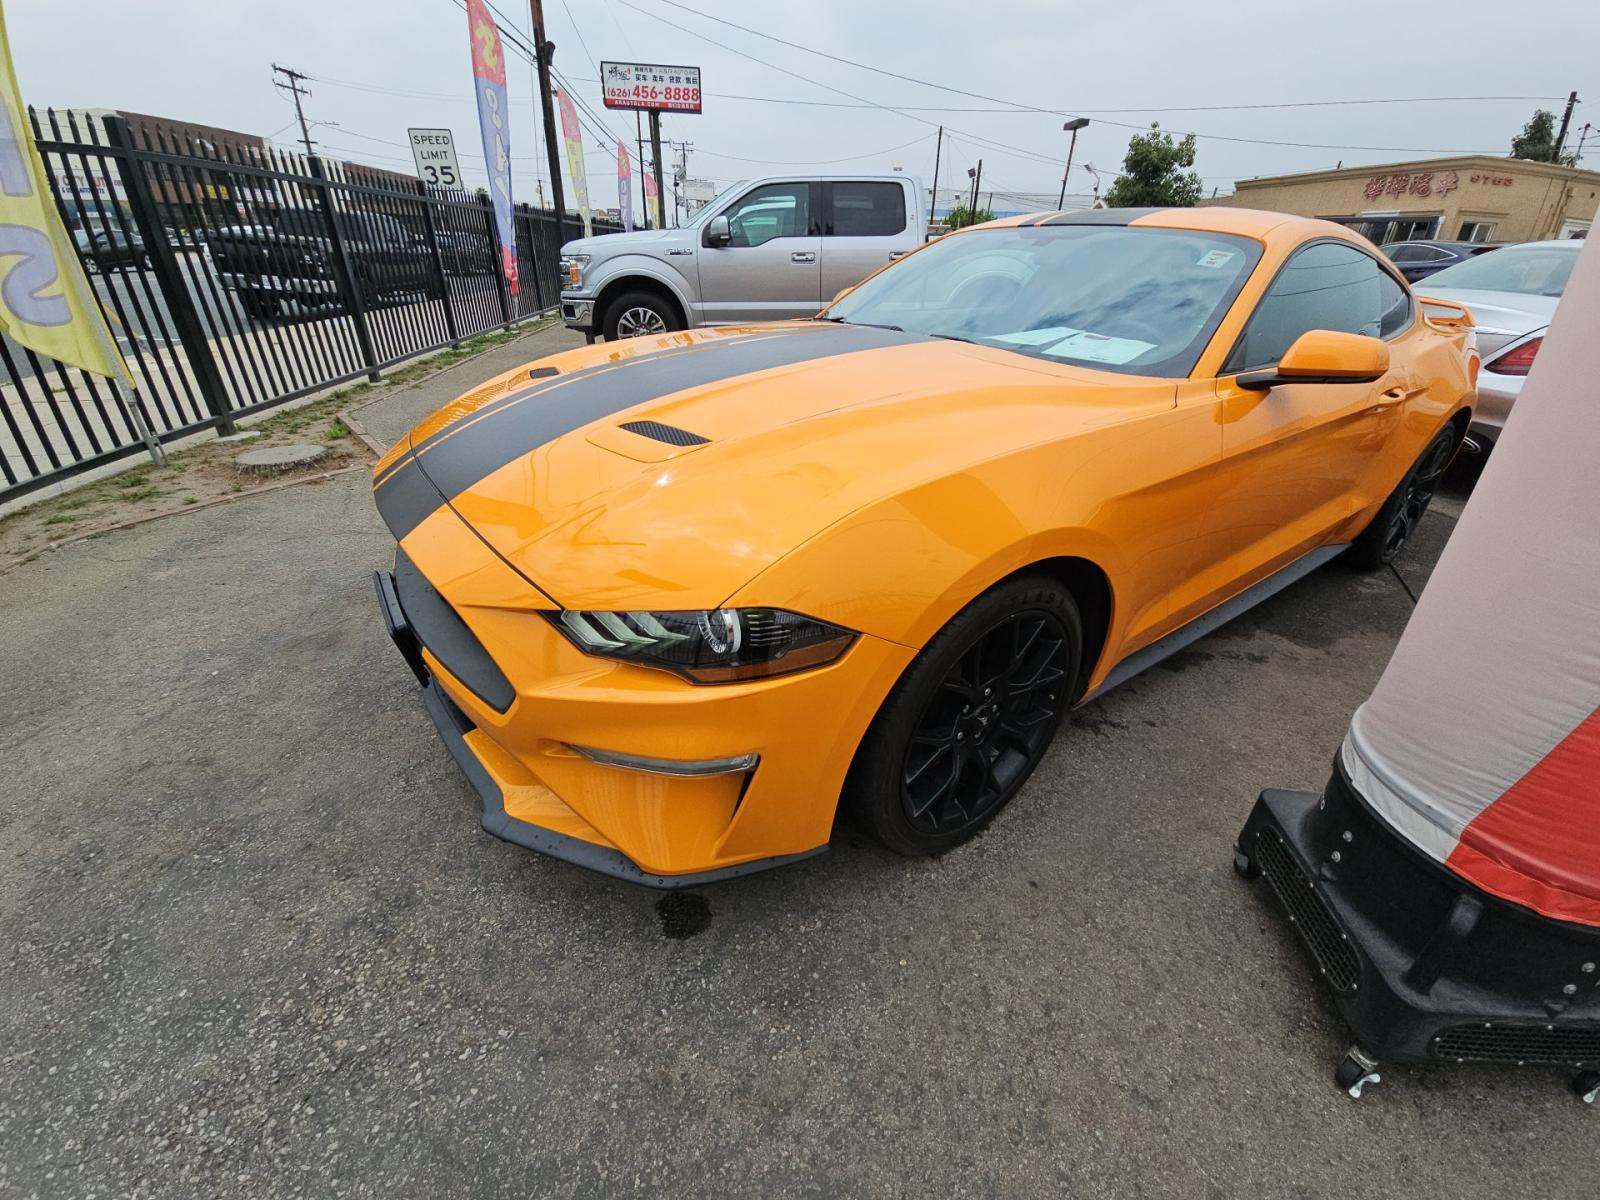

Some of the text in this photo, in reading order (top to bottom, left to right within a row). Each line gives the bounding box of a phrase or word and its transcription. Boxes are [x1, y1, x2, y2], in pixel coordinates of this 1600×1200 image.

[607, 85, 699, 101] (626) 456-8888
[413, 135, 450, 145] SPEED
[420, 150, 448, 160] LIMIT
[424, 165, 456, 185] 35
